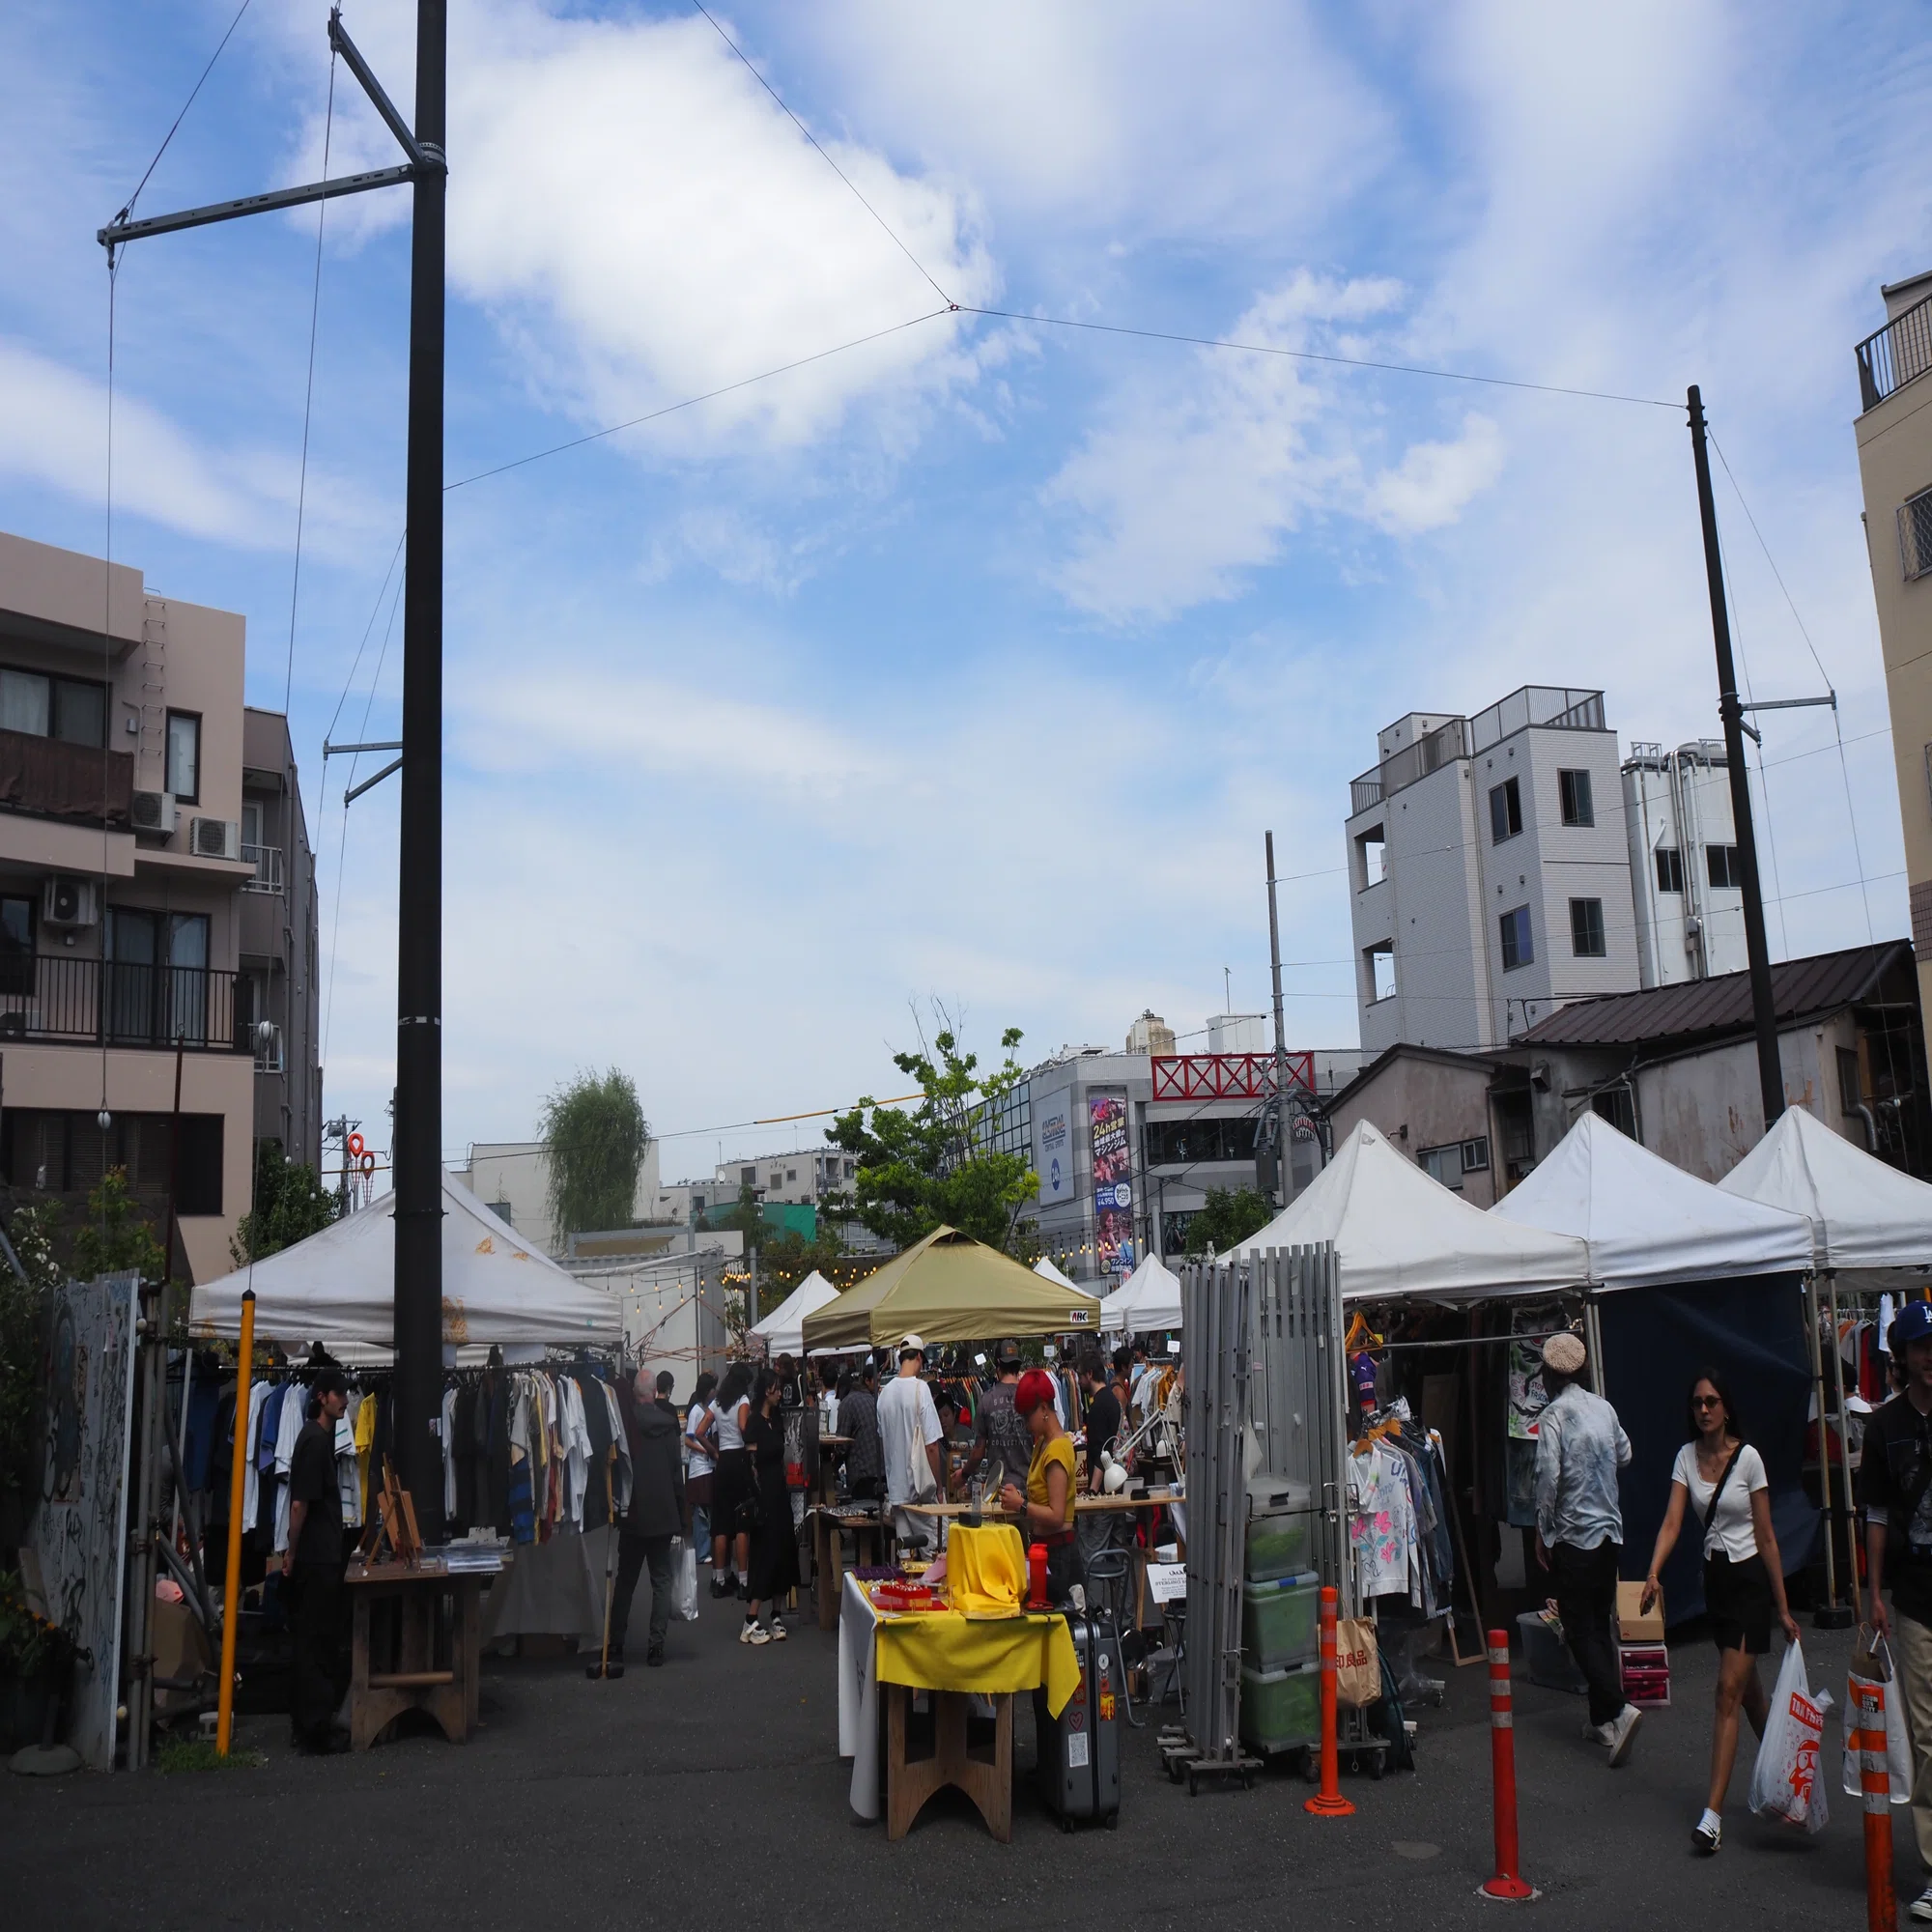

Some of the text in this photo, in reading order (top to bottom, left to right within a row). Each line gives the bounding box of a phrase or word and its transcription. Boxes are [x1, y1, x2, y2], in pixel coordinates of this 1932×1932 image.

[1094, 1117, 1124, 1139] 24h営業
[1094, 1137, 1126, 1156] マシンジム
[1071, 1312, 1087, 1322] ABC
[1336, 1650, 1368, 1669] 印良品
